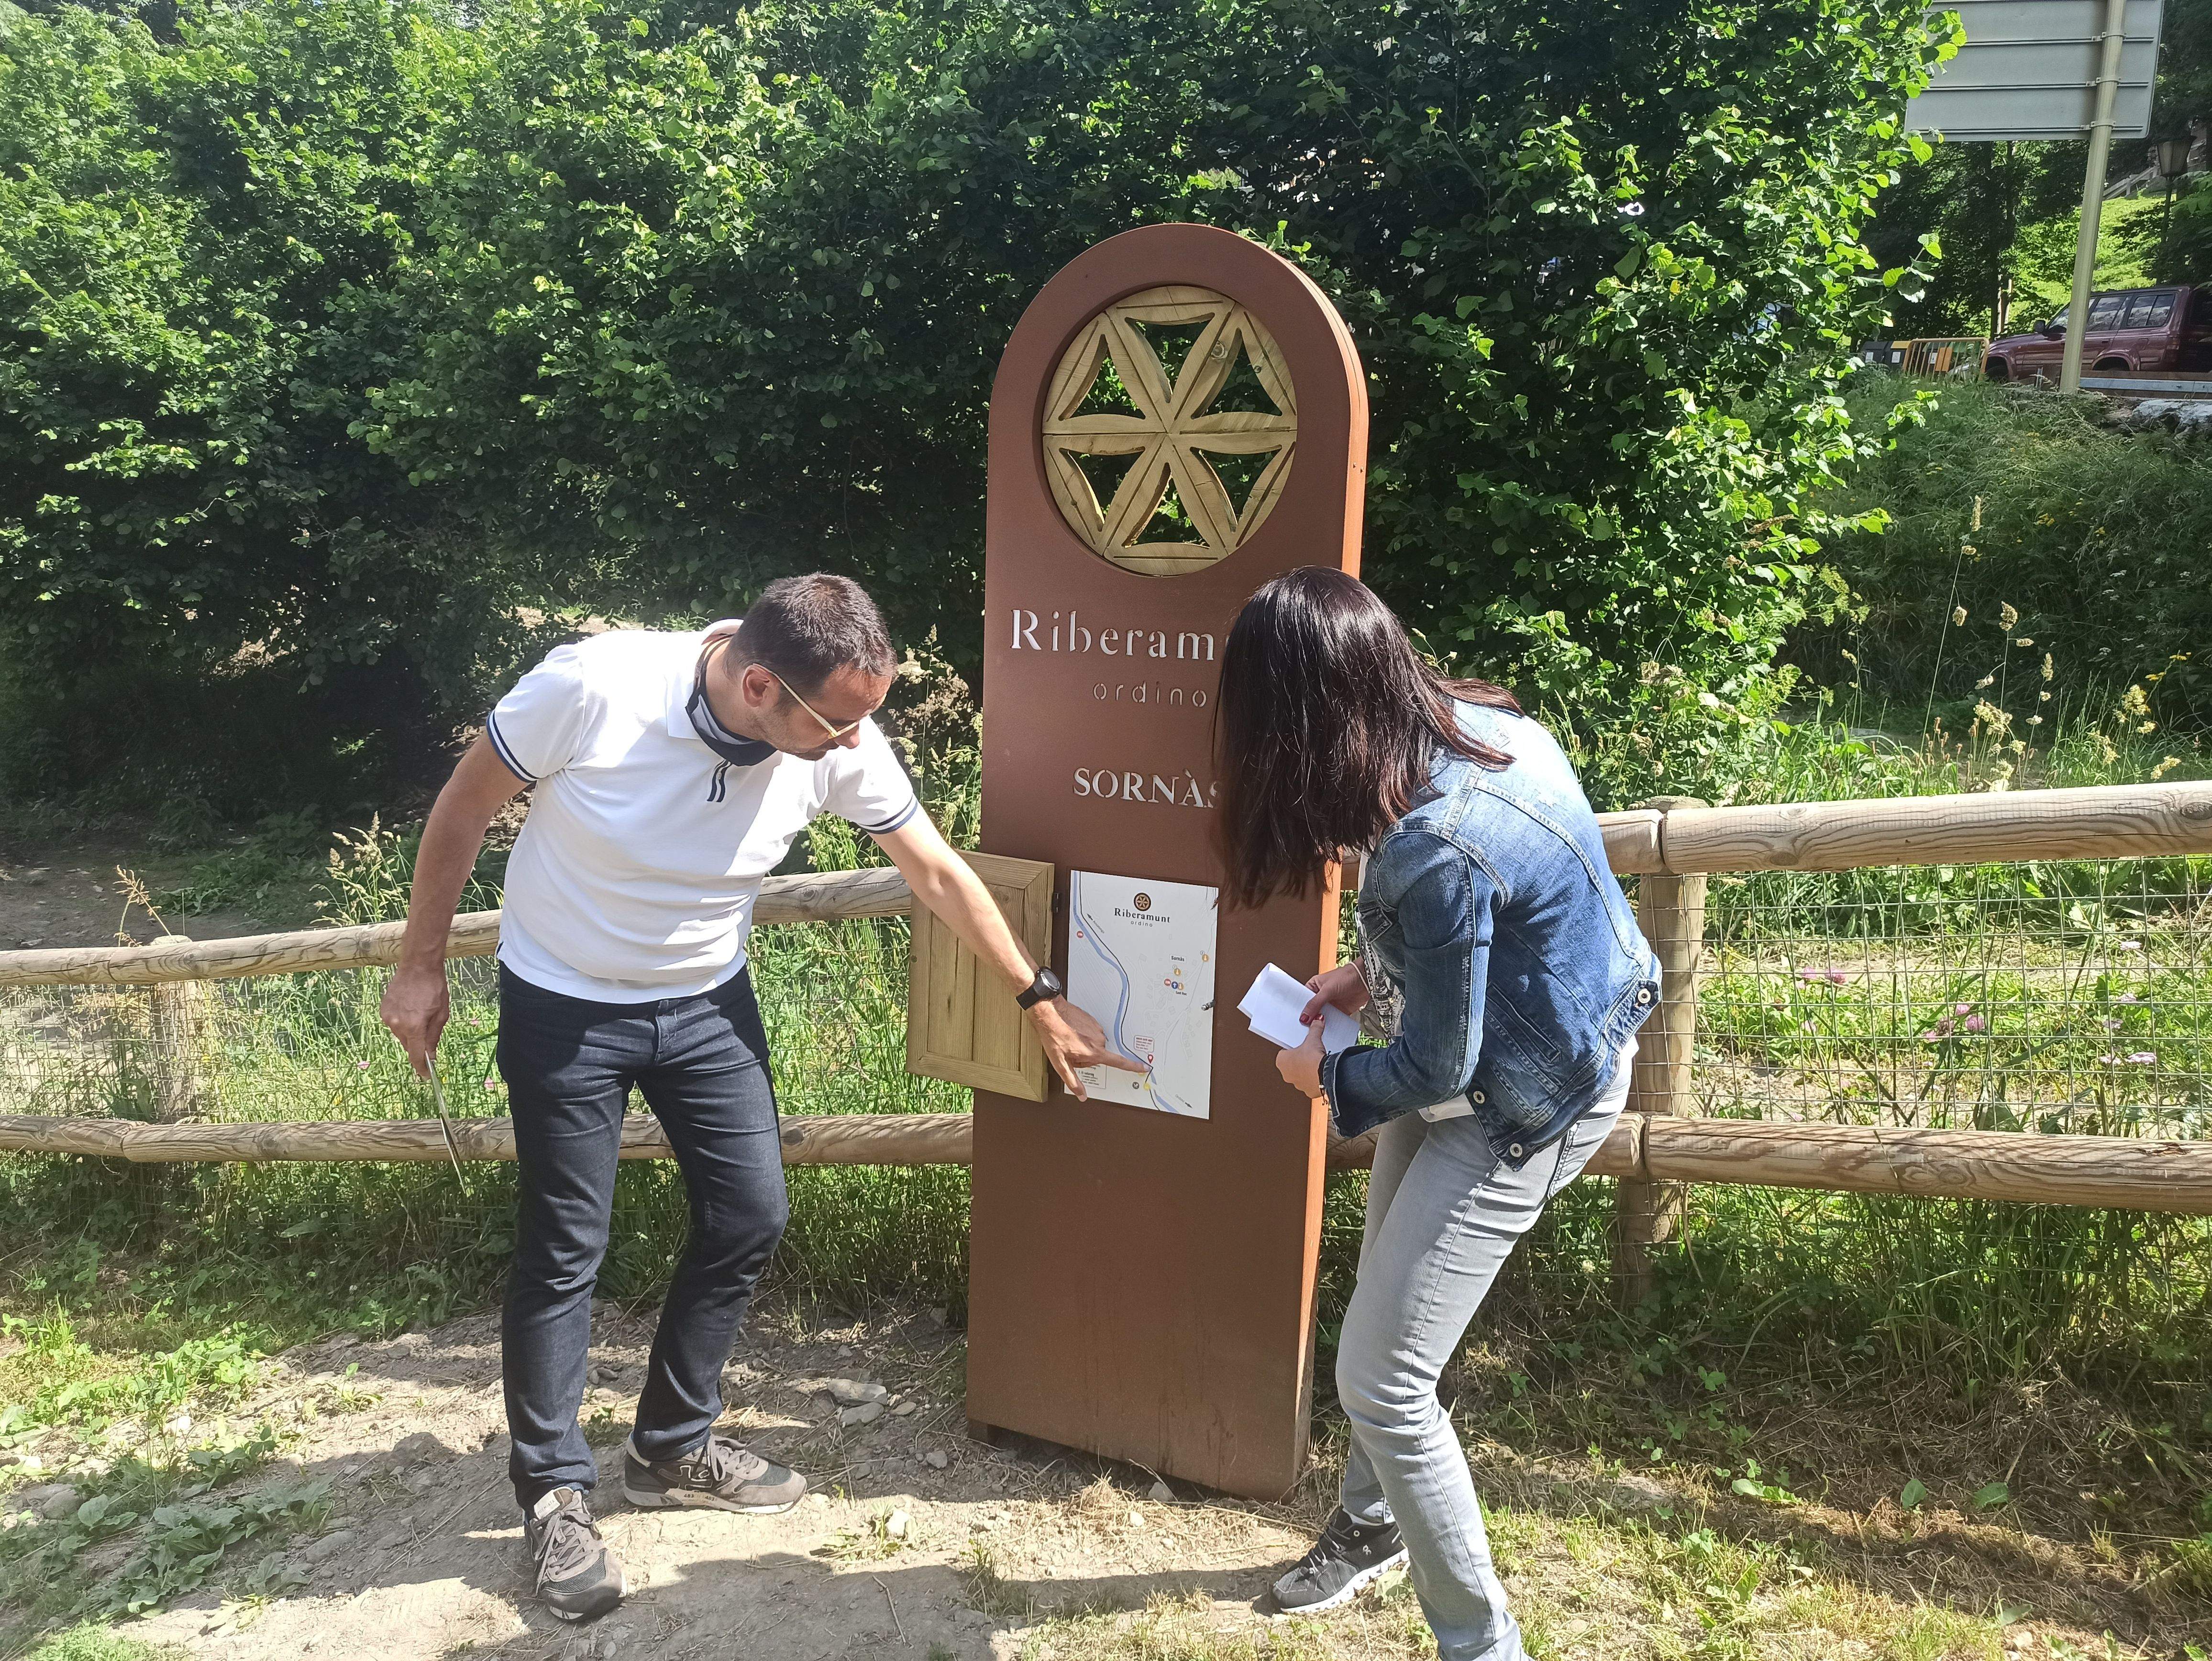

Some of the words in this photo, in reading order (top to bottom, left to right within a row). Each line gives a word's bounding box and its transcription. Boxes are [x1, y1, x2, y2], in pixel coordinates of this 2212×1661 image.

[1010, 609, 1230, 661] Riberam
[1093, 681, 1207, 708] ordino
[1114, 908, 1170, 923] Riberamunt
